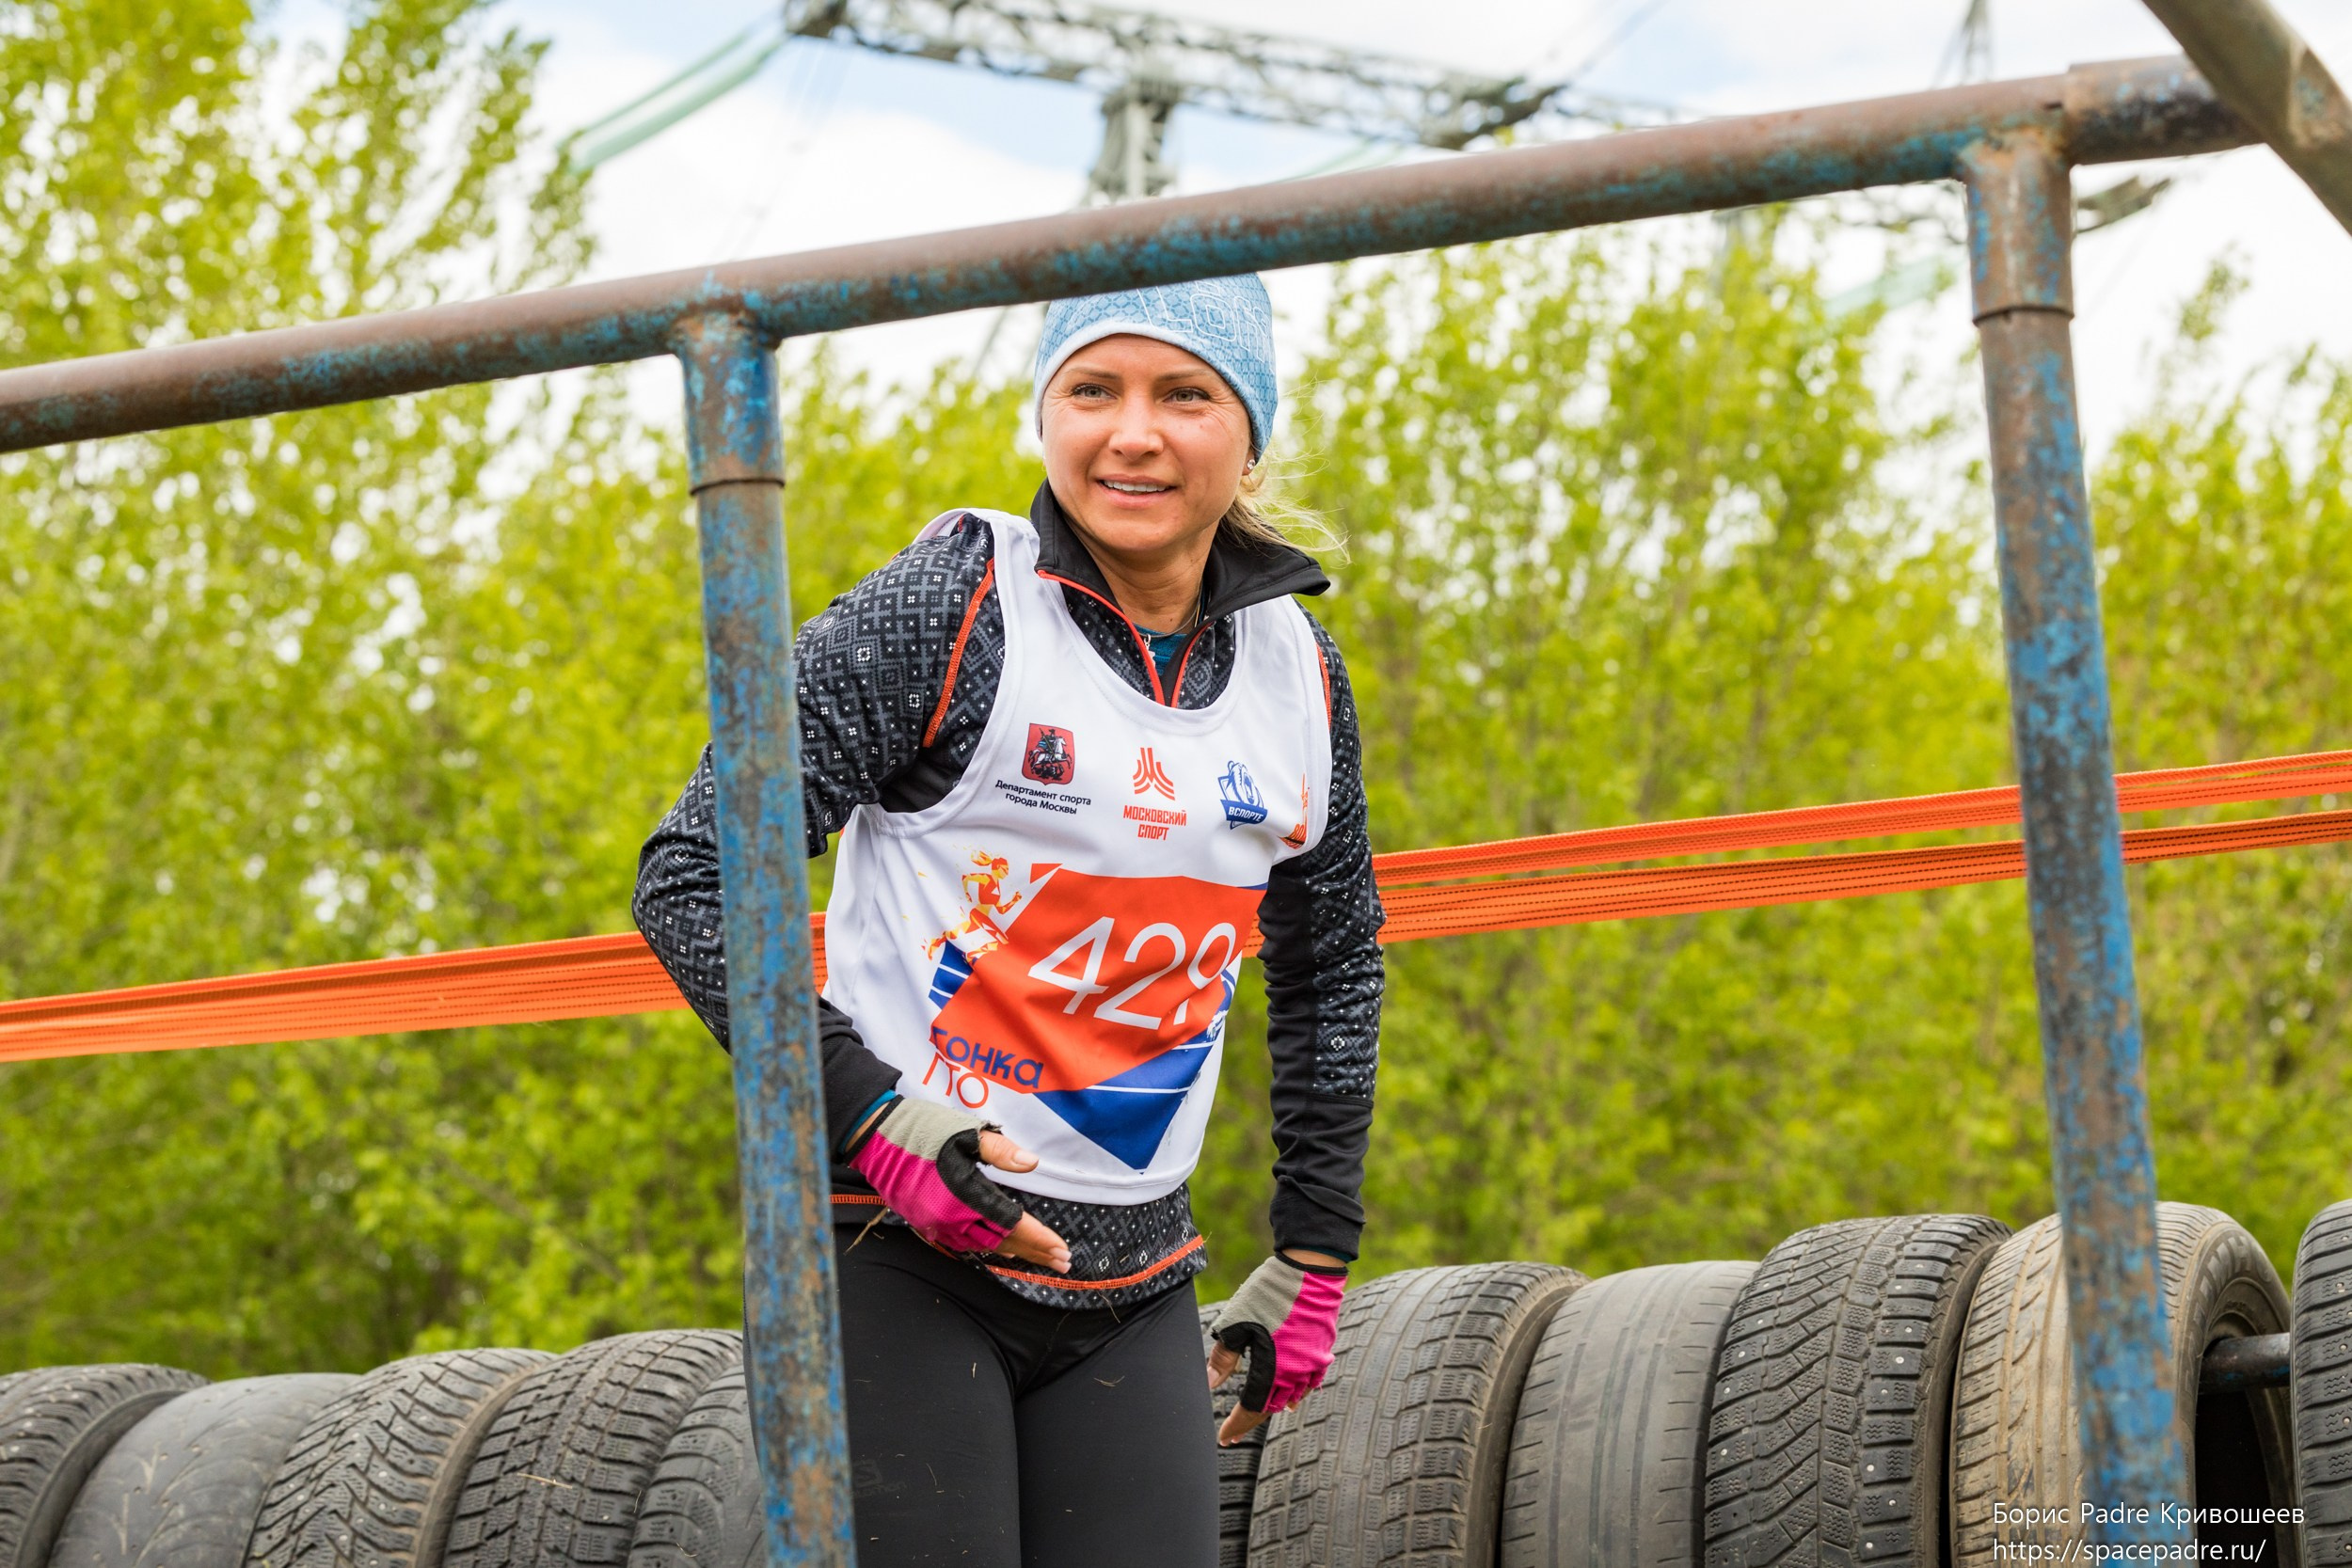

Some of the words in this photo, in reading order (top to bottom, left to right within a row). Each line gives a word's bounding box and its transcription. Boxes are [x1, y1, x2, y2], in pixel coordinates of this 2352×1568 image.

[995, 780, 1057, 800] Департамент
[1059, 794, 1091, 806] спорта
[1005, 792, 1038, 809] города
[1040, 800, 1077, 815] Москвы
[1123, 804, 1187, 827] МОСКОВСКИЙ
[1228, 806, 1263, 822] ВСПОРТЕ
[1137, 824, 1169, 841] СПОРТ
[1027, 915, 1236, 1031] 429
[932, 1025, 1044, 1089] Гонка
[922, 1052, 990, 1109] ГТО
